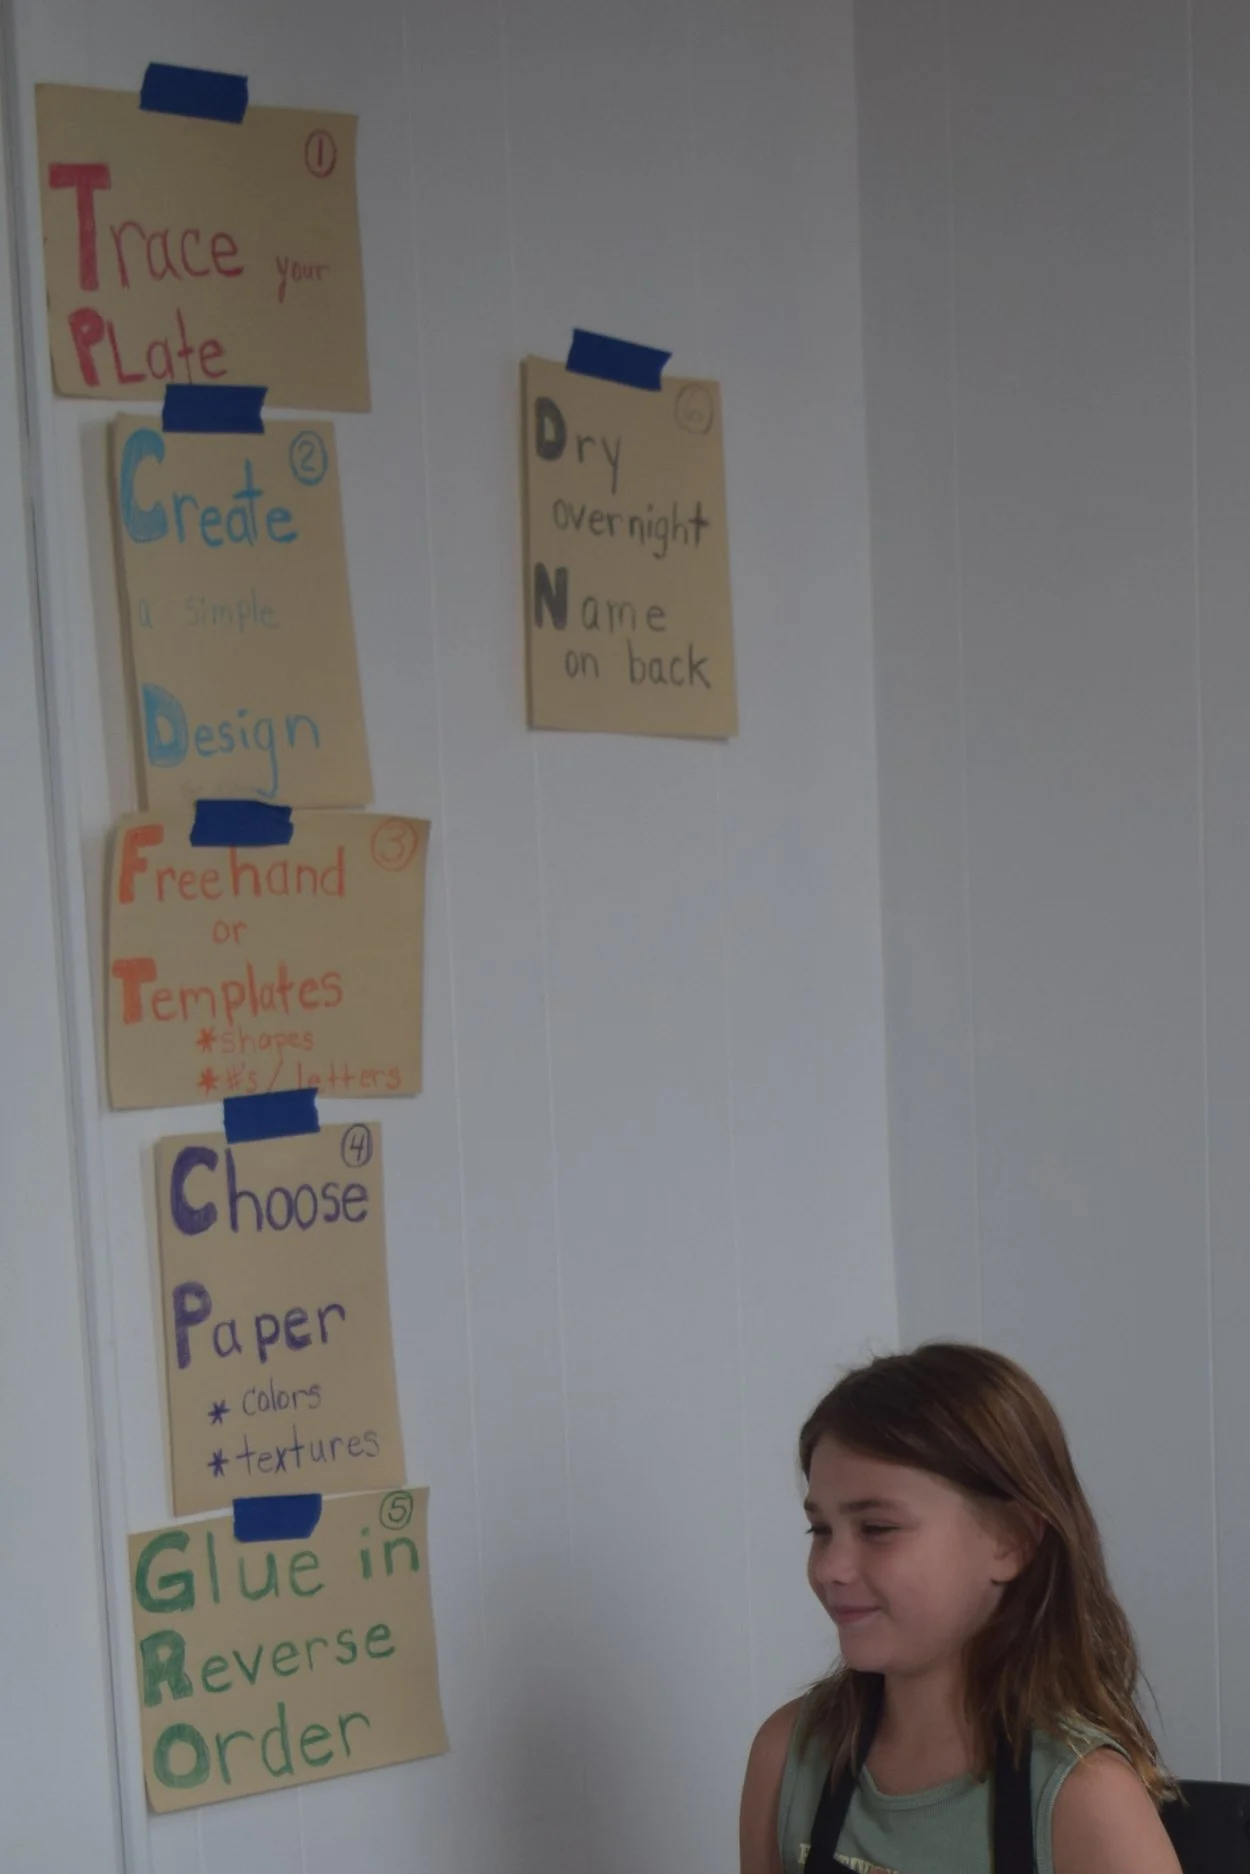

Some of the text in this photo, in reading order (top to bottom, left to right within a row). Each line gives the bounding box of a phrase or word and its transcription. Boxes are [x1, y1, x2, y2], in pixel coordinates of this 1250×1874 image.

[48, 163, 329, 303] Trace your
[120, 429, 297, 548] Create
[534, 397, 621, 495] Dry
[552, 498, 709, 558] overnight
[534, 562, 668, 633] Name
[565, 639, 711, 690] on back
[142, 683, 320, 798] Design
[118, 824, 346, 904] Freehand
[212, 920, 248, 944] or
[111, 957, 343, 1027] Templates
[170, 1146, 368, 1236] Choose
[172, 1281, 346, 1369] Paper
[236, 1424, 379, 1477] textures
[135, 1527, 420, 1613] Glue in
[140, 1623, 396, 1708] Reverse
[153, 1702, 370, 1789] Order
